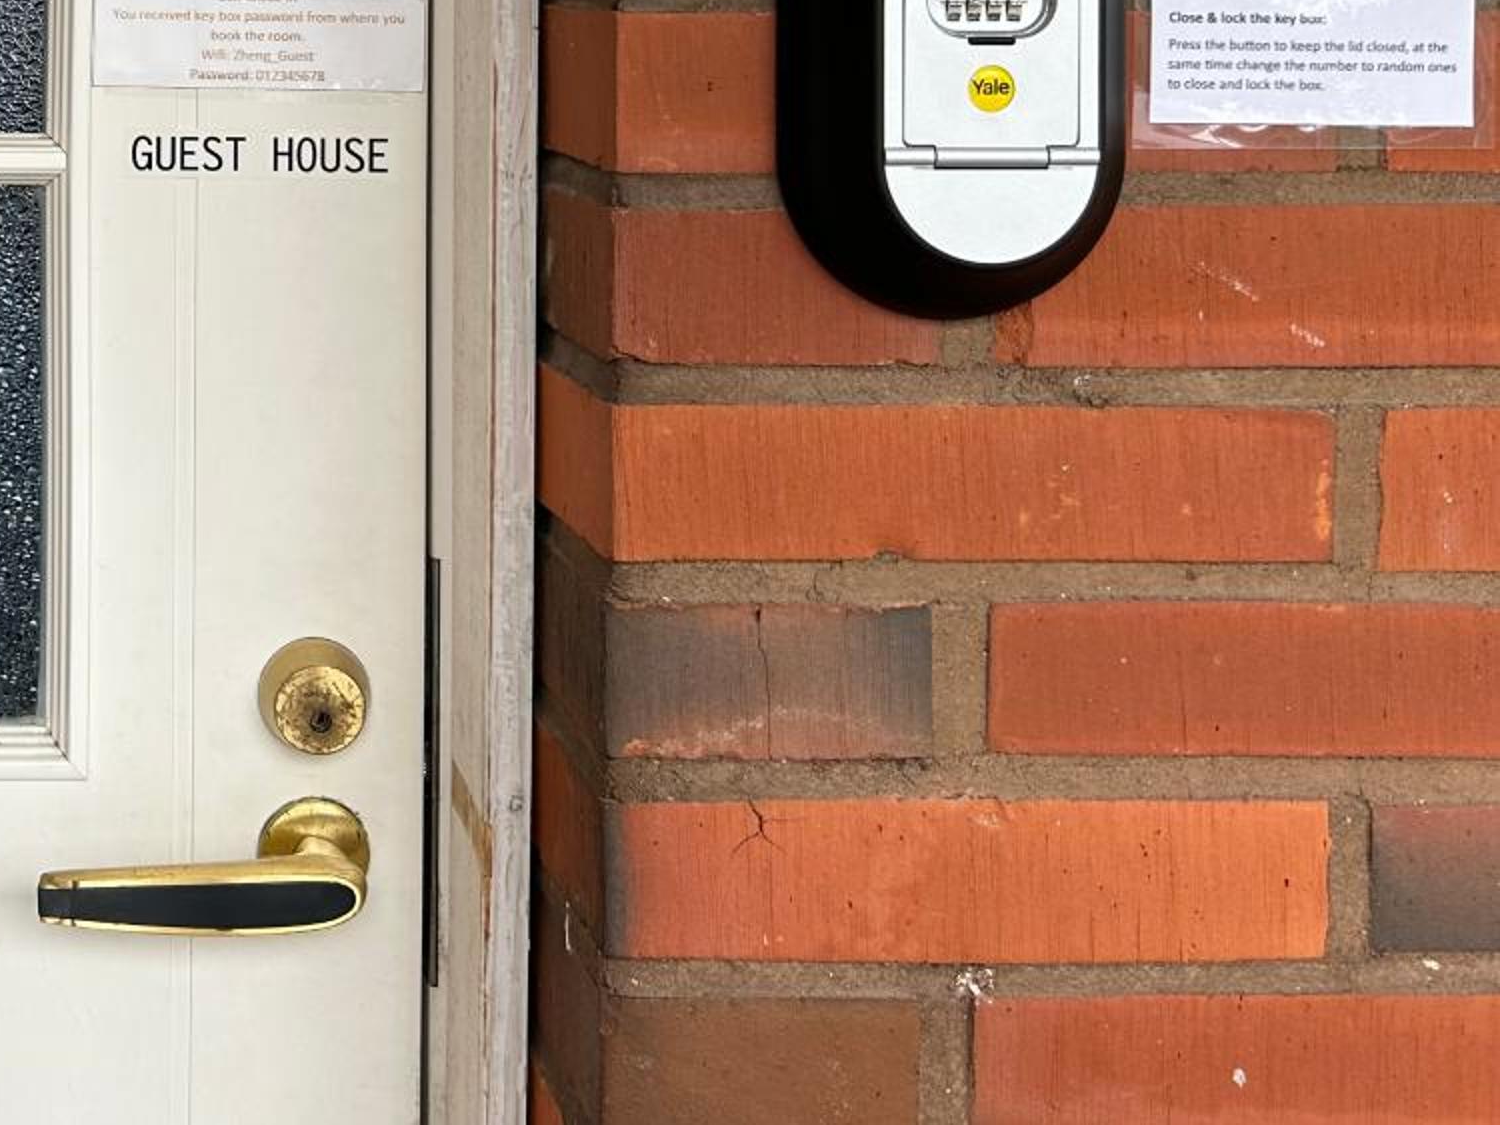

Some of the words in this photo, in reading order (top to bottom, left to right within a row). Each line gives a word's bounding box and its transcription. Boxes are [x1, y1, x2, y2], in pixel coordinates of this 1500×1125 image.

[114, 8, 137, 20] You
[139, 10, 191, 21] received
[195, 10, 215, 24] key
[219, 11, 242, 22] box
[244, 11, 304, 24] password
[307, 11, 337, 24] from
[339, 12, 380, 24] where
[382, 13, 406, 26] you
[1169, 11, 1203, 24] Close
[1206, 12, 1218, 24] &
[1221, 11, 1246, 24] lock
[1249, 12, 1271, 24] the
[1274, 12, 1297, 26] key
[211, 29, 241, 41] book
[245, 30, 266, 41] the
[1169, 38, 1201, 50] Press
[1205, 38, 1226, 51] the
[1229, 38, 1271, 51] button
[1274, 40, 1287, 51] to
[1290, 40, 1321, 54] keep
[1323, 40, 1345, 52] the
[1348, 40, 1363, 52] lid
[1366, 40, 1409, 54] closed,
[1412, 42, 1424, 53] at
[1427, 42, 1448, 53] the
[1167, 60, 1201, 70] same
[1205, 59, 1233, 70] time
[1236, 59, 1281, 73] change
[1284, 59, 1306, 71] the
[1309, 60, 1358, 72] number
[1361, 61, 1375, 72] to
[1377, 61, 1425, 72] random
[1428, 62, 1457, 73] ones
[972, 79, 1010, 96] Yale
[1167, 78, 1181, 90] to
[1183, 78, 1216, 90] close
[1219, 78, 1243, 90] and
[1246, 78, 1270, 90] lock
[1274, 78, 1296, 90] the
[1299, 79, 1325, 92] box.
[131, 135, 247, 172] GUEST
[273, 137, 389, 174] HOUSE
